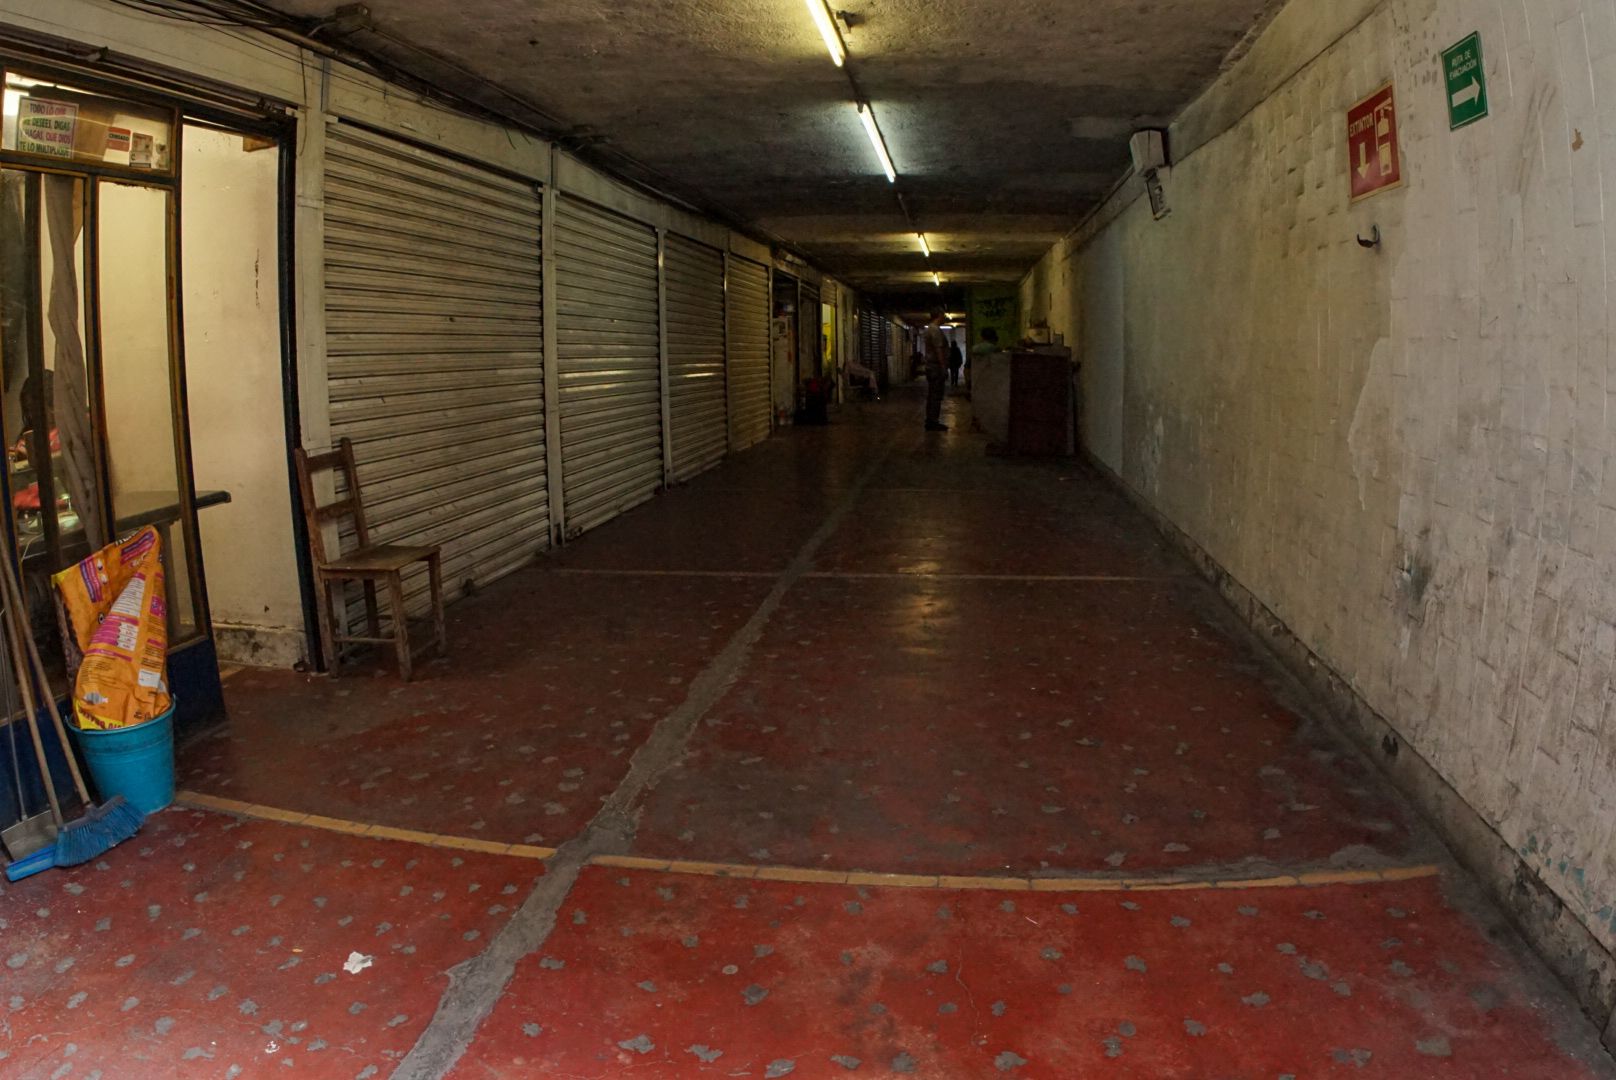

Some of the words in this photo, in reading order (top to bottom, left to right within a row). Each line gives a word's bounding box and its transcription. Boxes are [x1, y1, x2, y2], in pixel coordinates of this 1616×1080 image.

[30, 103, 45, 115] TODO
[58, 133, 71, 145] DIOS
[27, 142, 35, 152] LO
